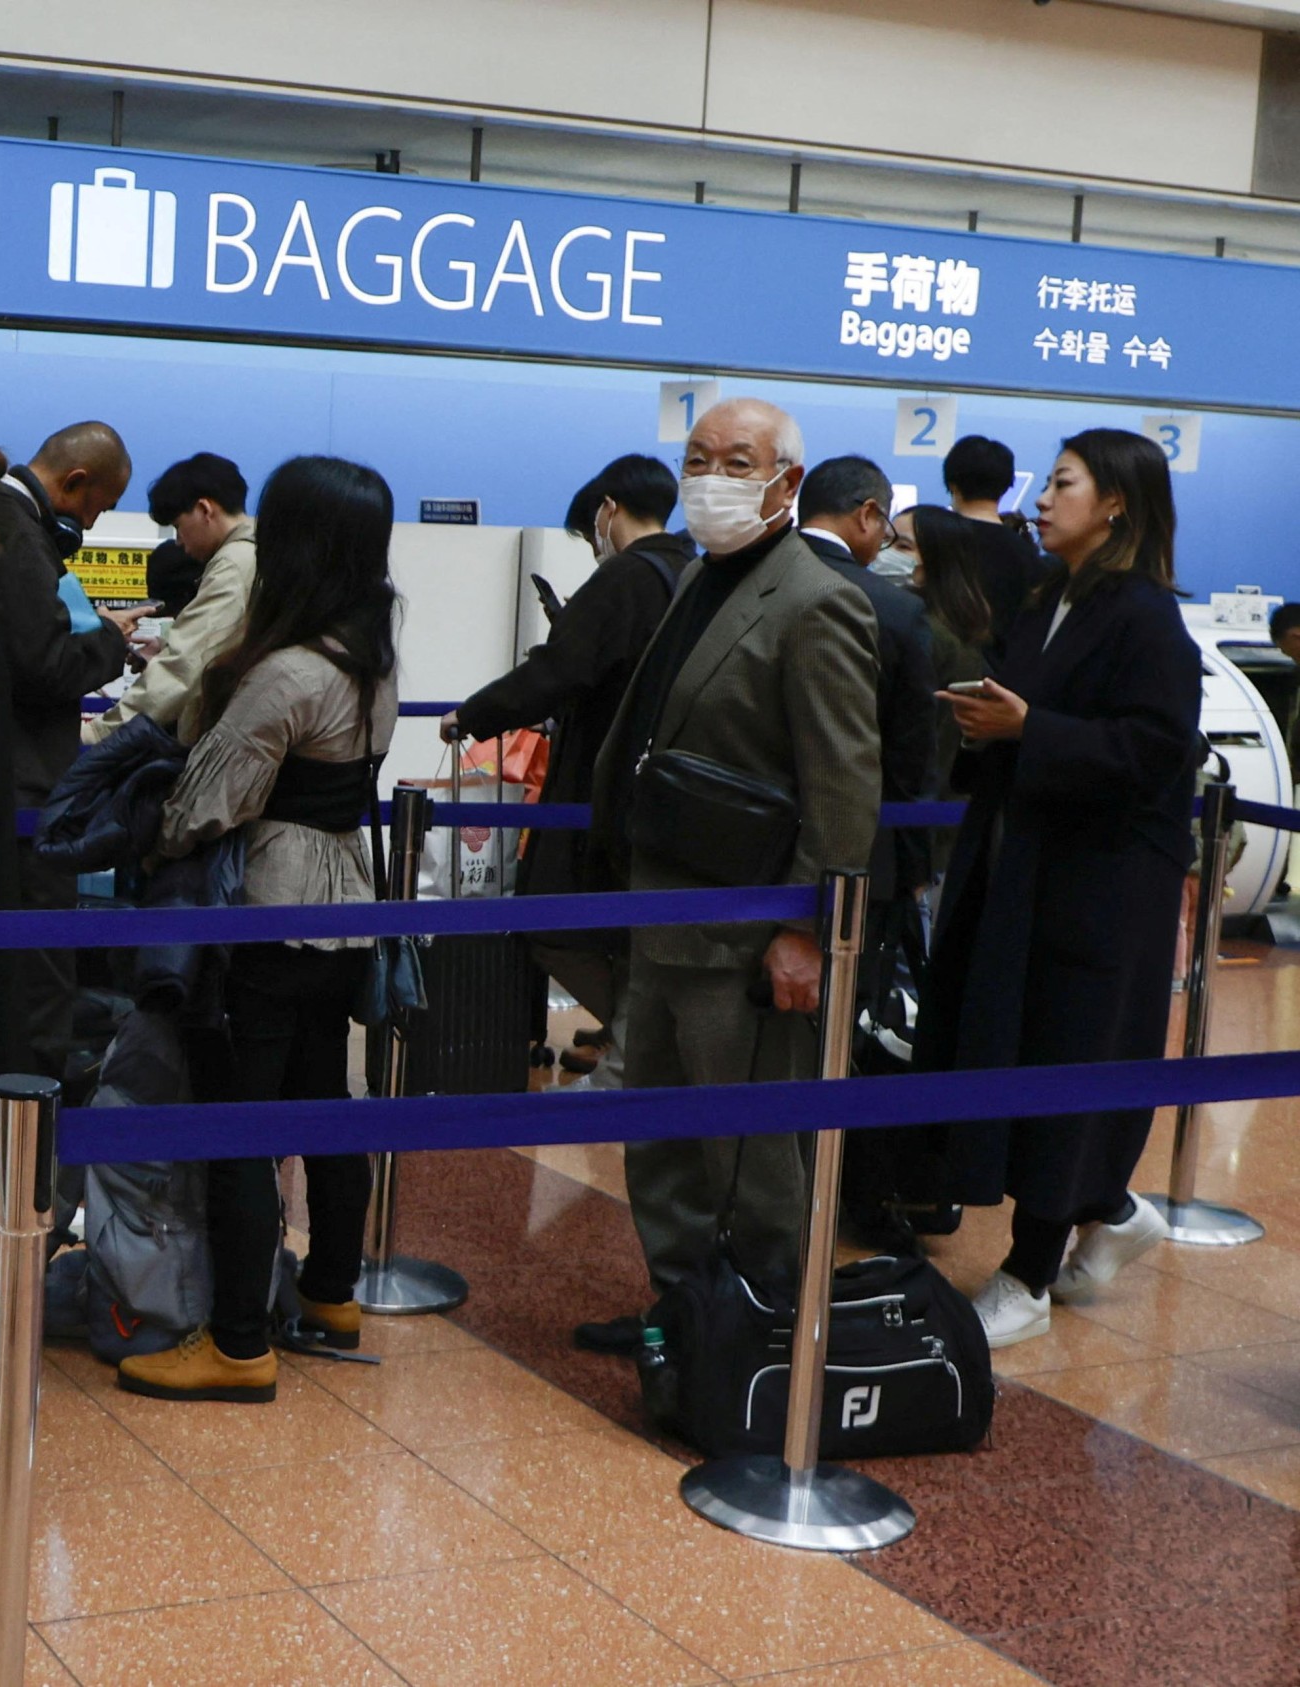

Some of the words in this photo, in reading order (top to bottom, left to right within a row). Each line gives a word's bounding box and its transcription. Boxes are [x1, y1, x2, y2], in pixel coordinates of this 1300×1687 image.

[206, 193, 665, 325] BAGGAGE
[843, 252, 980, 317] 手荷物
[1037, 275, 1137, 317] 行李托运
[840, 310, 971, 361] Baggage
[1033, 328, 1110, 364] 수화물
[1122, 334, 1172, 370] 수속
[679, 392, 696, 432] 1
[910, 407, 938, 446] 2
[1160, 425, 1181, 461] 3
[842, 1386, 881, 1429] FJ
